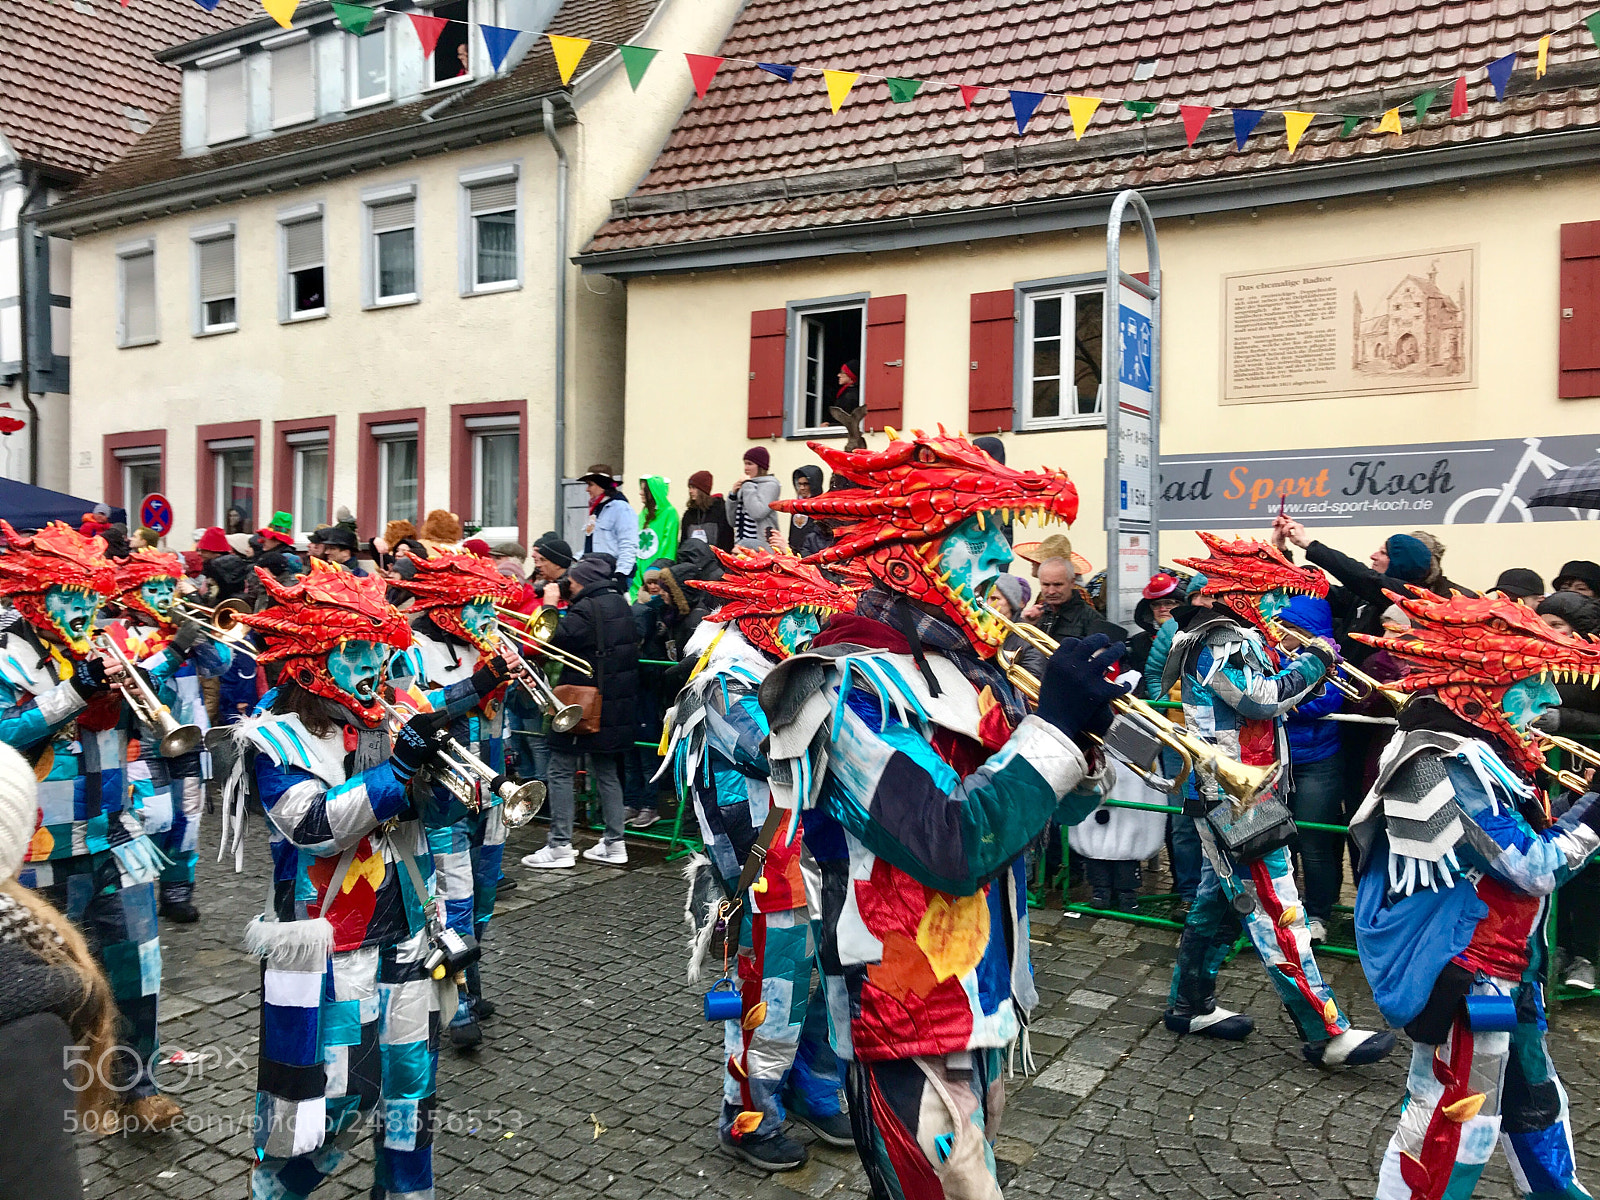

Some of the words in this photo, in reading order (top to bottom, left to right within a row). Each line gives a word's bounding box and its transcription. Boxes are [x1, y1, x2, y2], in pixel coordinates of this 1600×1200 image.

[1238, 284, 1253, 292] Das
[1256, 279, 1301, 289] ehemalige
[1303, 275, 1333, 284] Badtor
[1160, 469, 1213, 501] ad
[1223, 466, 1331, 510] Sport
[1341, 459, 1455, 496] Koch
[1267, 498, 1433, 514] www.rad-sport-koch.de
